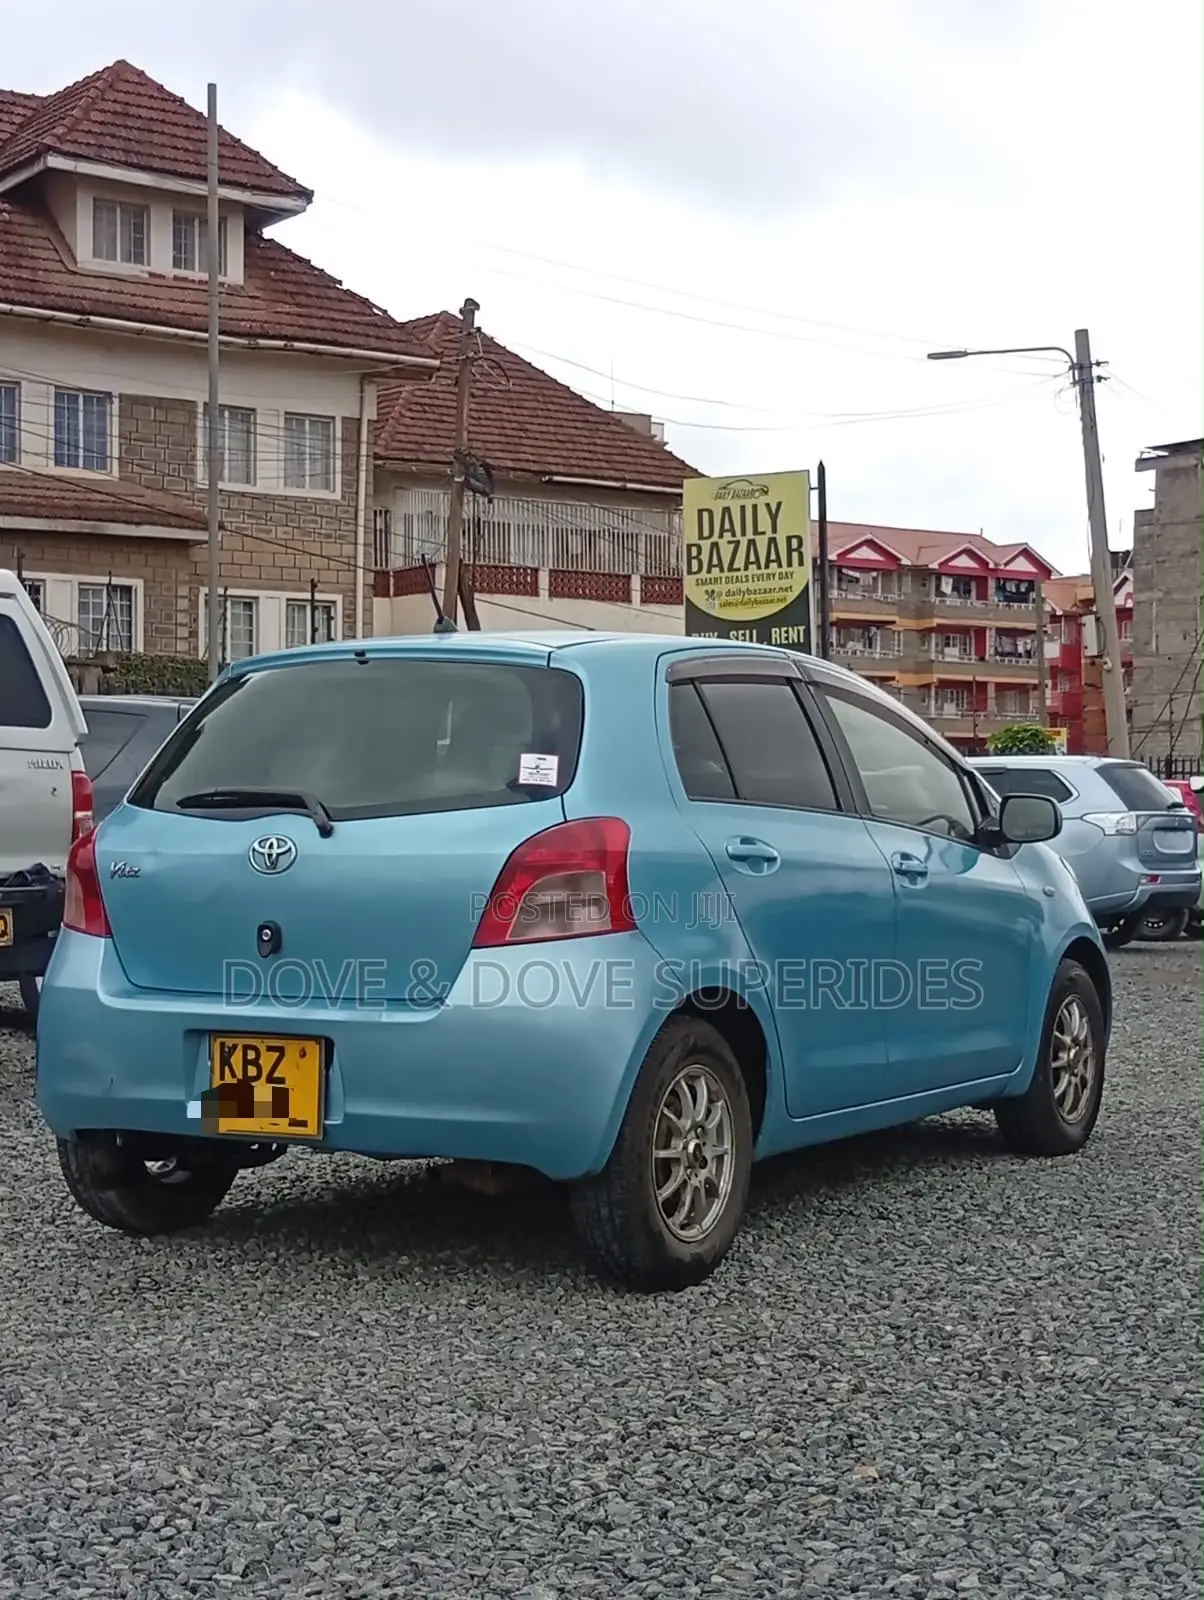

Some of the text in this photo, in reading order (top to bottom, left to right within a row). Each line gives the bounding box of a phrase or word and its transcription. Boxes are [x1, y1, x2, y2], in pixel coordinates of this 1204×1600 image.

[697, 501, 783, 540] DAILY
[686, 535, 805, 575] BAZAAR
[695, 571, 794, 586] SMART DEALS EVERY DAY
[771, 625, 806, 645] RENT
[219, 1041, 286, 1085] KBZ
